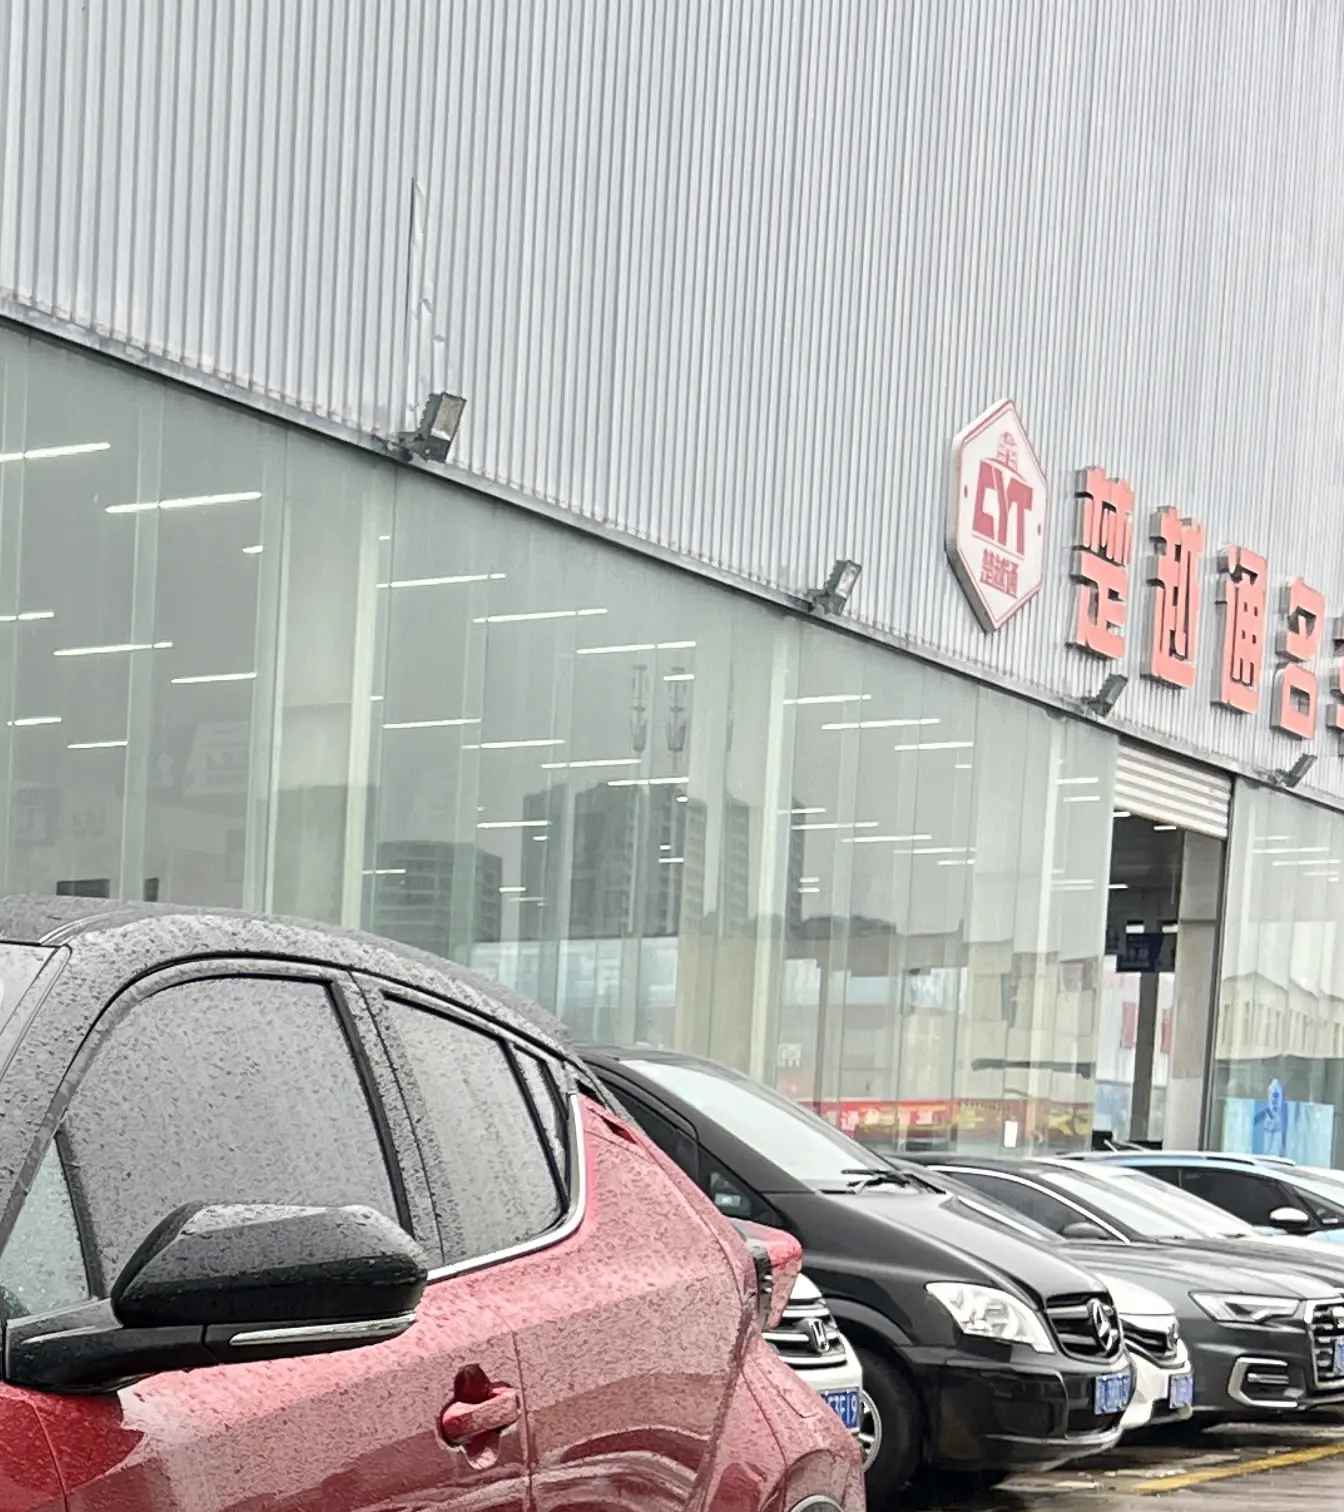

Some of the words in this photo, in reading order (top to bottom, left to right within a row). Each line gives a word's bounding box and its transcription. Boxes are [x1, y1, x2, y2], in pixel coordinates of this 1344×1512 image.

[972, 459, 1033, 556] CYT
[1071, 464, 1344, 756] 楚越通名
